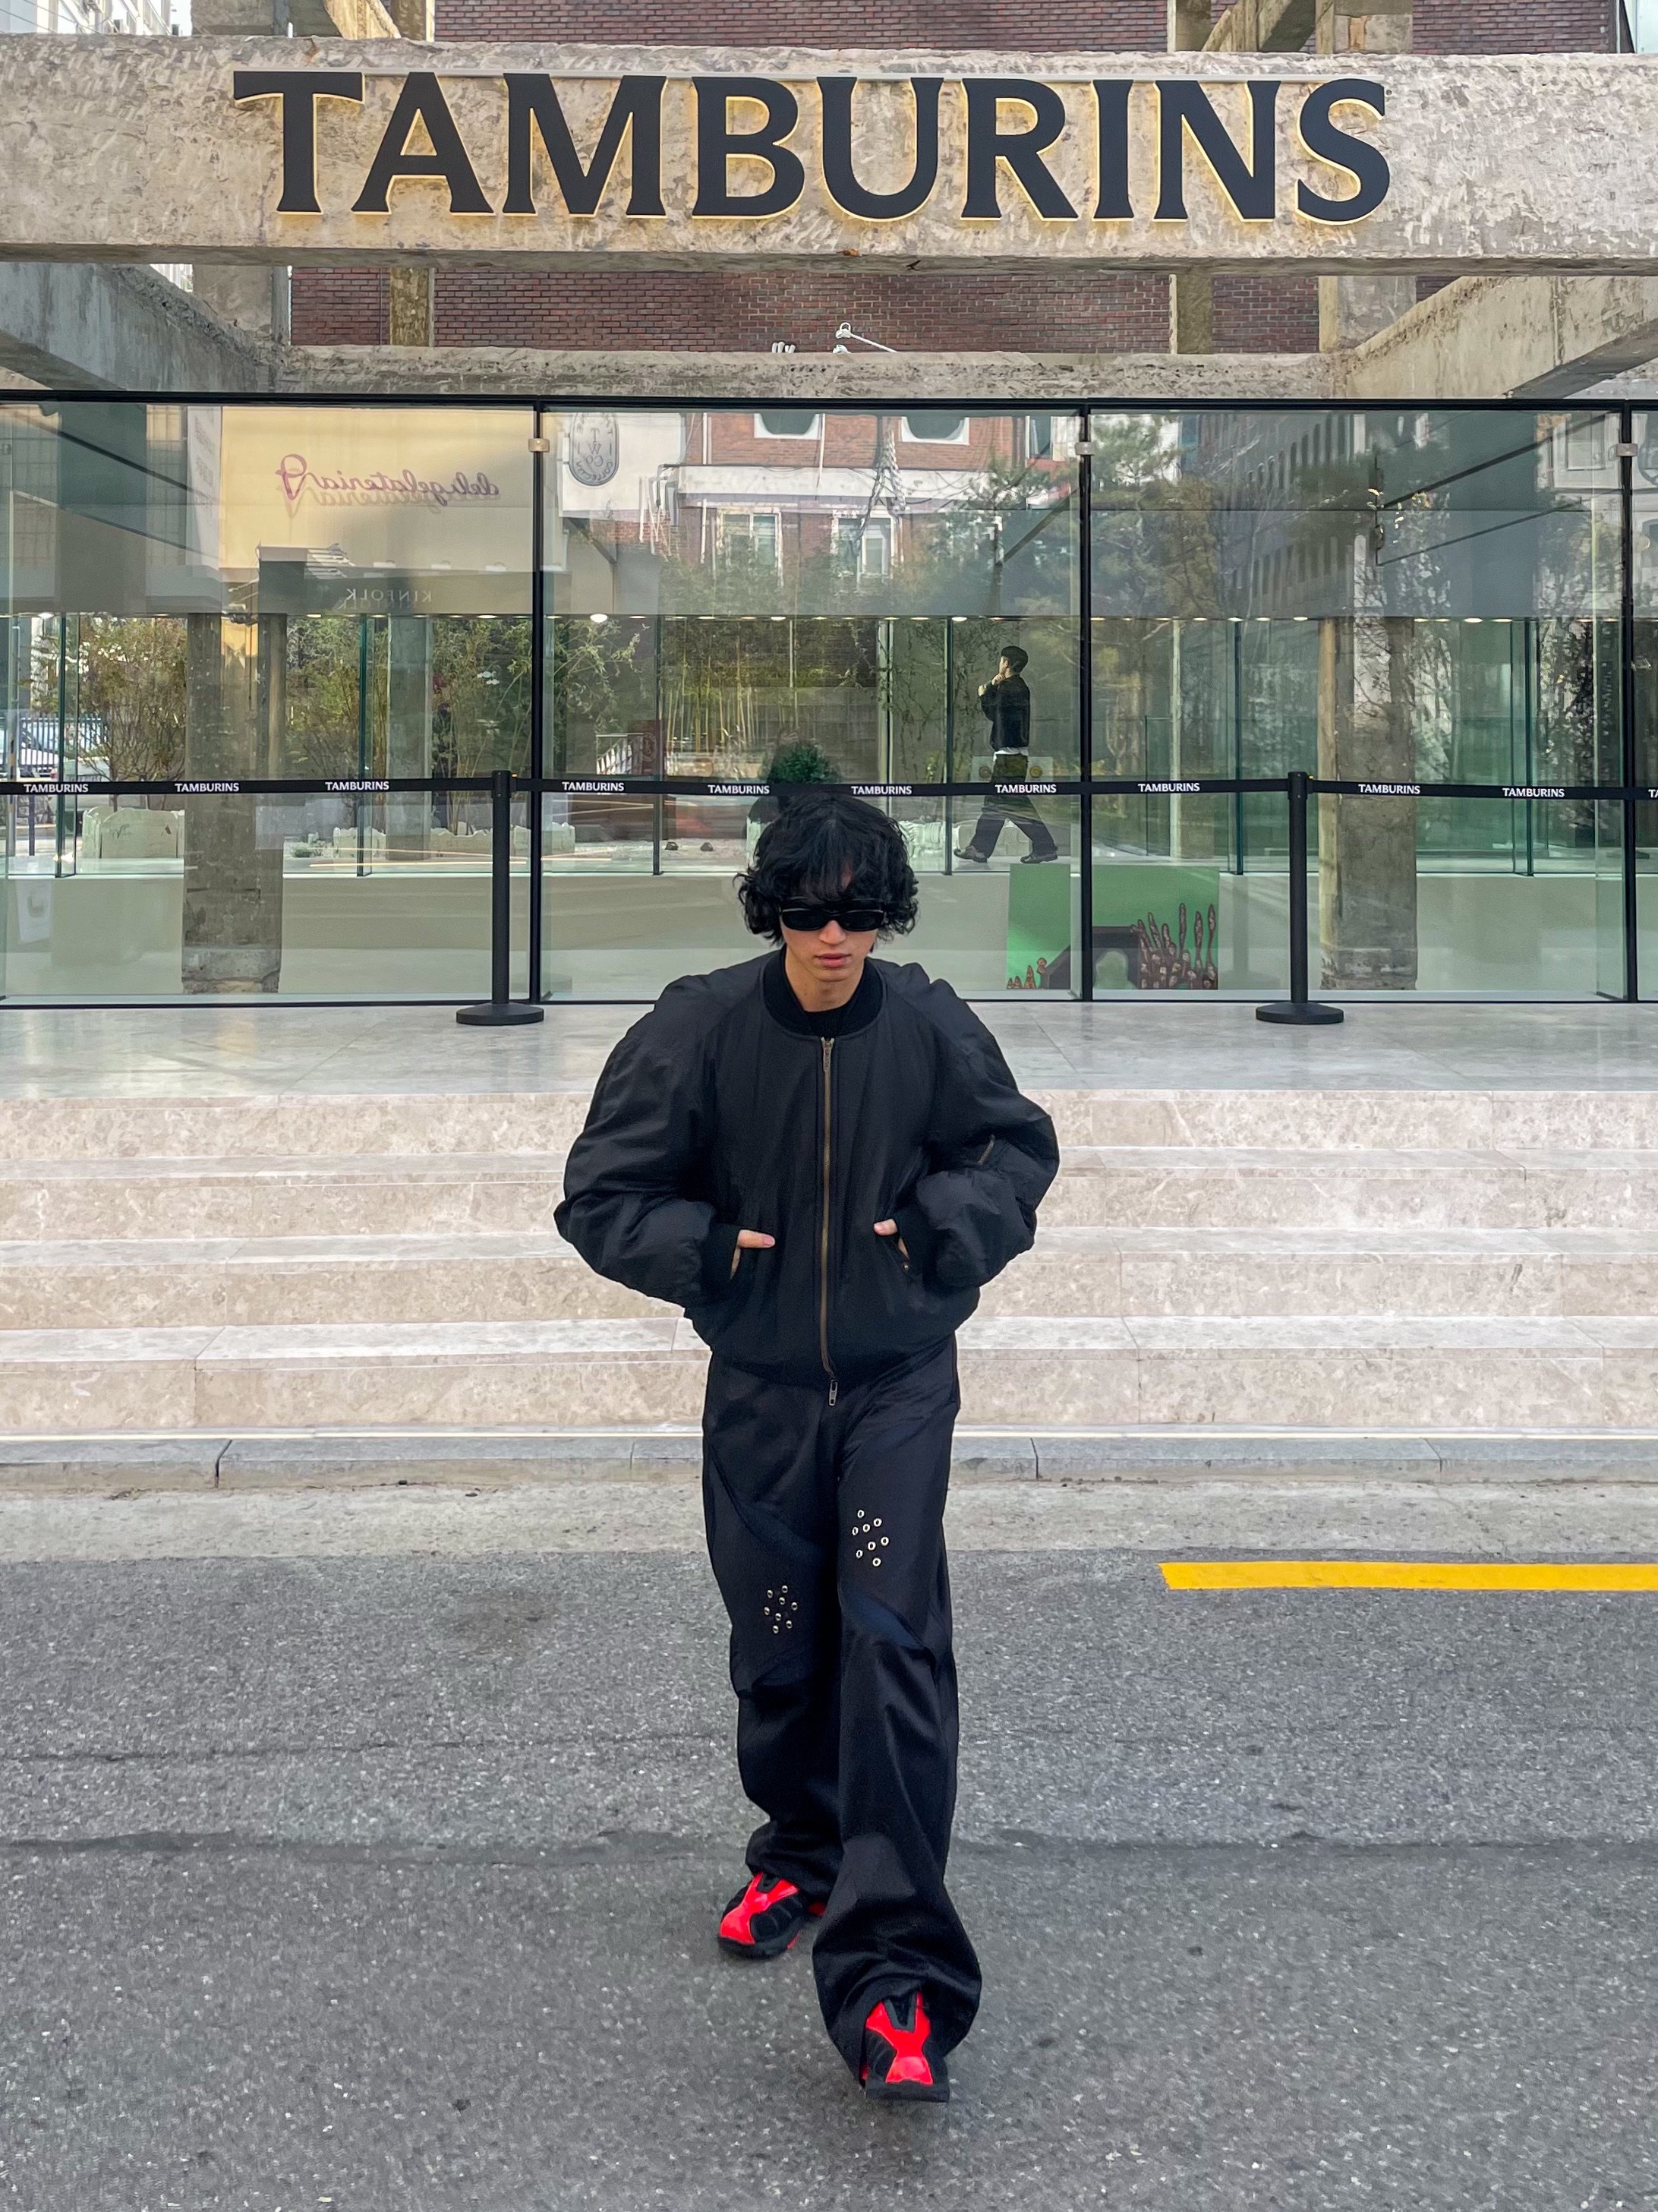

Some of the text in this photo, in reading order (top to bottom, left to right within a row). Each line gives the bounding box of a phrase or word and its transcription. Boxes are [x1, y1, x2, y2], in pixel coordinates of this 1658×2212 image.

[233, 71, 1390, 222] TAMBURINS
[23, 784, 89, 793] TAMBURINS
[175, 783, 240, 792] TAMBURINS
[324, 781, 389, 790] TAMBURINS
[562, 782, 625, 791] TAMBURINS
[708, 785, 770, 794] TAMBURINS
[851, 785, 913, 794] TAMBURINS
[994, 784, 1057, 794] TAMBURINS
[1138, 783, 1200, 792] TAMBURINS
[1358, 784, 1421, 794] TAMBURINS
[1502, 787, 1565, 797] TAMBURINS
